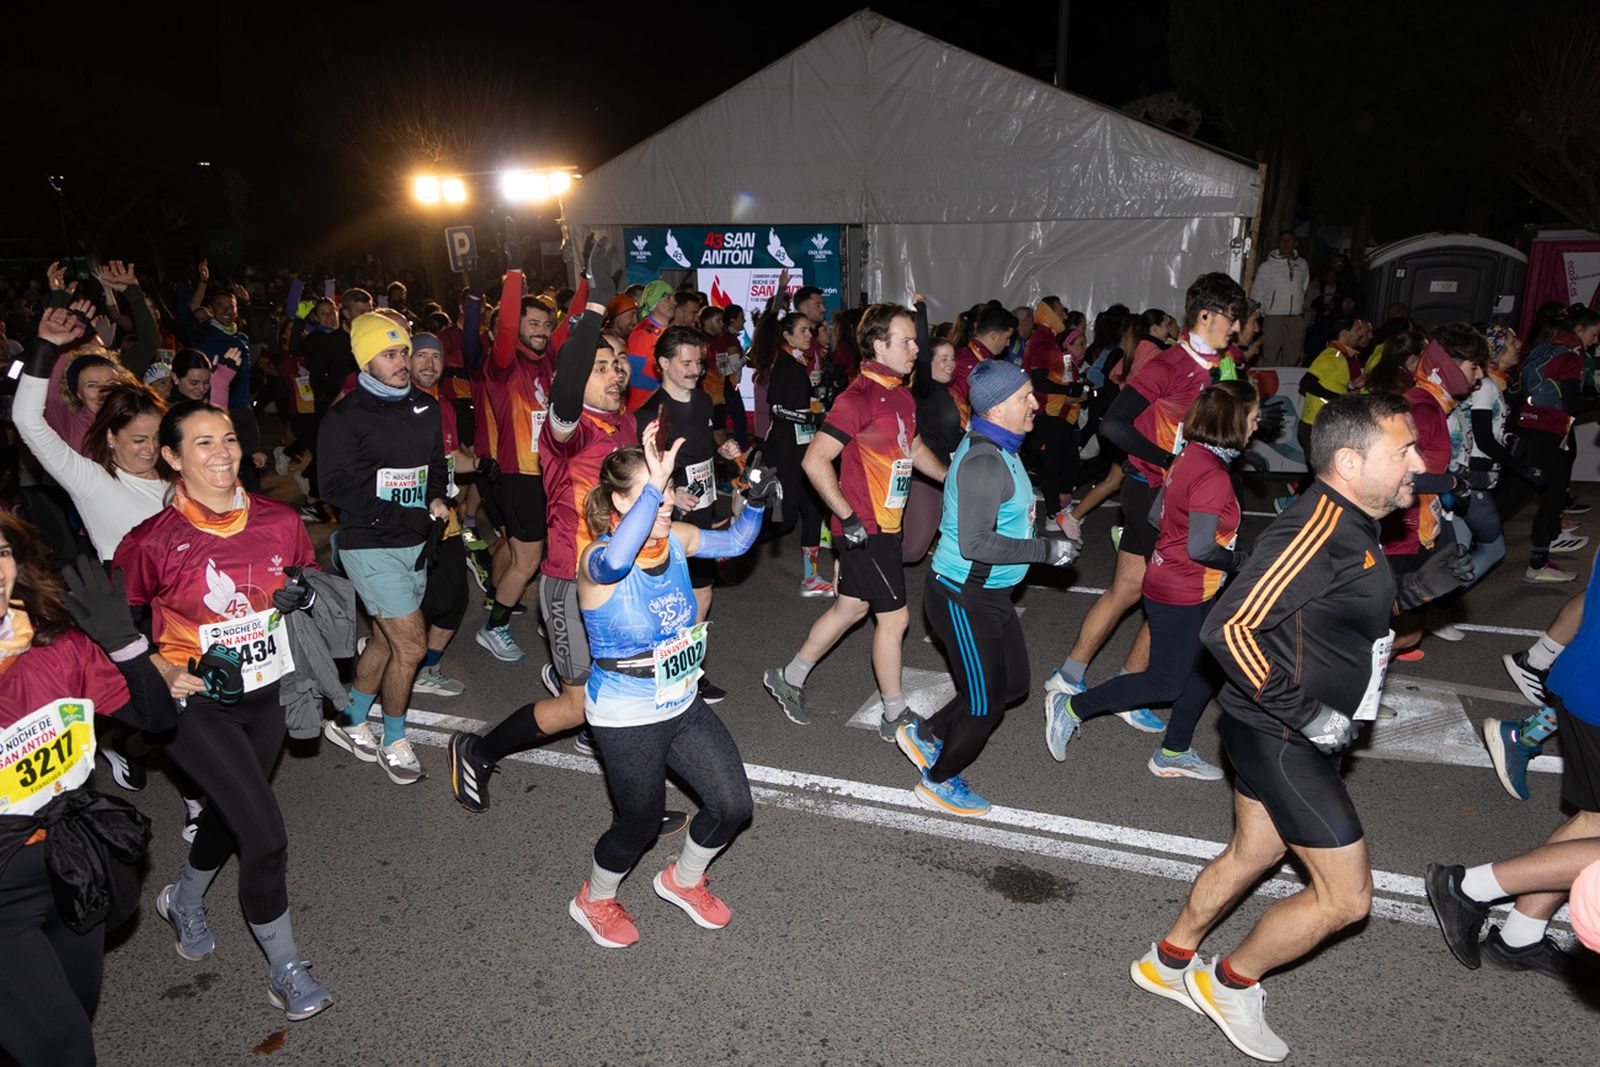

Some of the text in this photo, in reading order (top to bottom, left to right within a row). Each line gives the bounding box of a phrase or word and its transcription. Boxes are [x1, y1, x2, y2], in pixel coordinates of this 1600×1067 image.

[453, 232, 470, 266] P
[704, 232, 756, 249] 43 SAN
[701, 244, 753, 265] ANTÓN
[751, 285, 775, 297] SAN
[391, 486, 423, 503] 8074
[224, 599, 249, 618] 43
[658, 603, 677, 626] 25
[223, 621, 263, 637] NOCHE DE
[660, 649, 672, 660] SAN
[662, 641, 703, 680] 13002
[6, 725, 39, 752] NOCHE
[38, 717, 52, 731] DE
[0, 751, 20, 769] SAN
[15, 729, 73, 787] 3217
